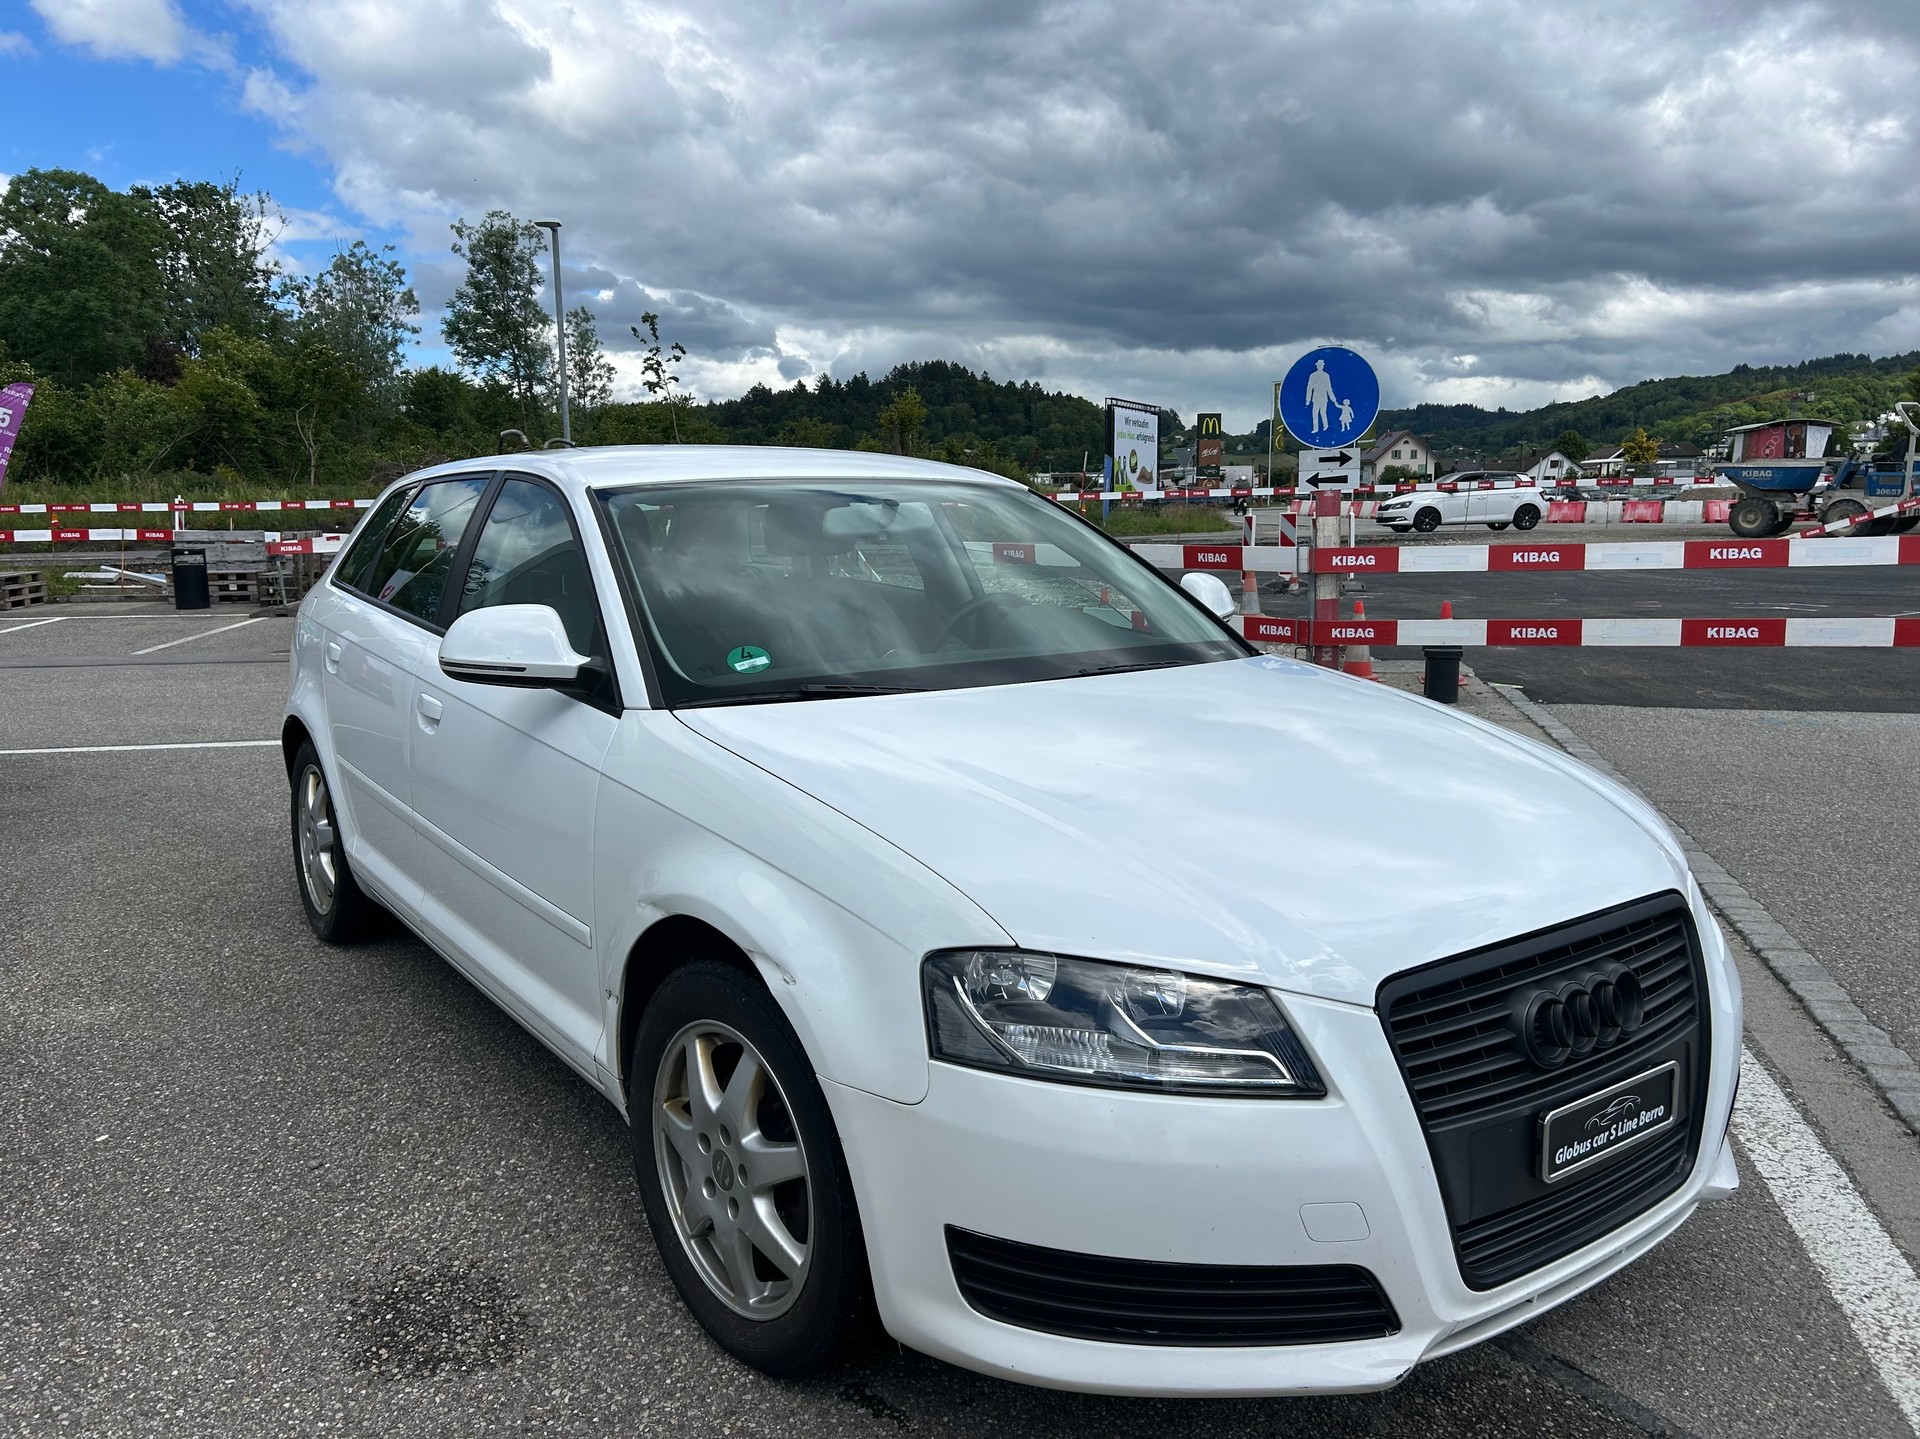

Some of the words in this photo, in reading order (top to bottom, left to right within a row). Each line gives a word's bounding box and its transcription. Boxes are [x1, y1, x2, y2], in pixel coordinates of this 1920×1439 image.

[1132, 418, 1149, 429] verkaufen
[1742, 469, 1773, 479] KIBAG
[1875, 488, 1902, 496] 30657
[1197, 552, 1228, 563] KIBAG
[1512, 551, 1560, 563] KIBAG
[1709, 547, 1763, 560] KIBAG
[1331, 554, 1376, 566] KIBAG
[1259, 623, 1291, 637] KIBAG
[1331, 627, 1375, 639] KIBAG
[1510, 627, 1558, 639] KIBAG
[1706, 626, 1759, 639] KIBAG
[741, 647, 753, 659] 4
[1555, 1139, 1591, 1165] Globus
[1592, 1132, 1609, 1148] car
[1610, 1126, 1617, 1140] S
[1617, 1117, 1637, 1137] Line
[1639, 1105, 1665, 1126] Berro
